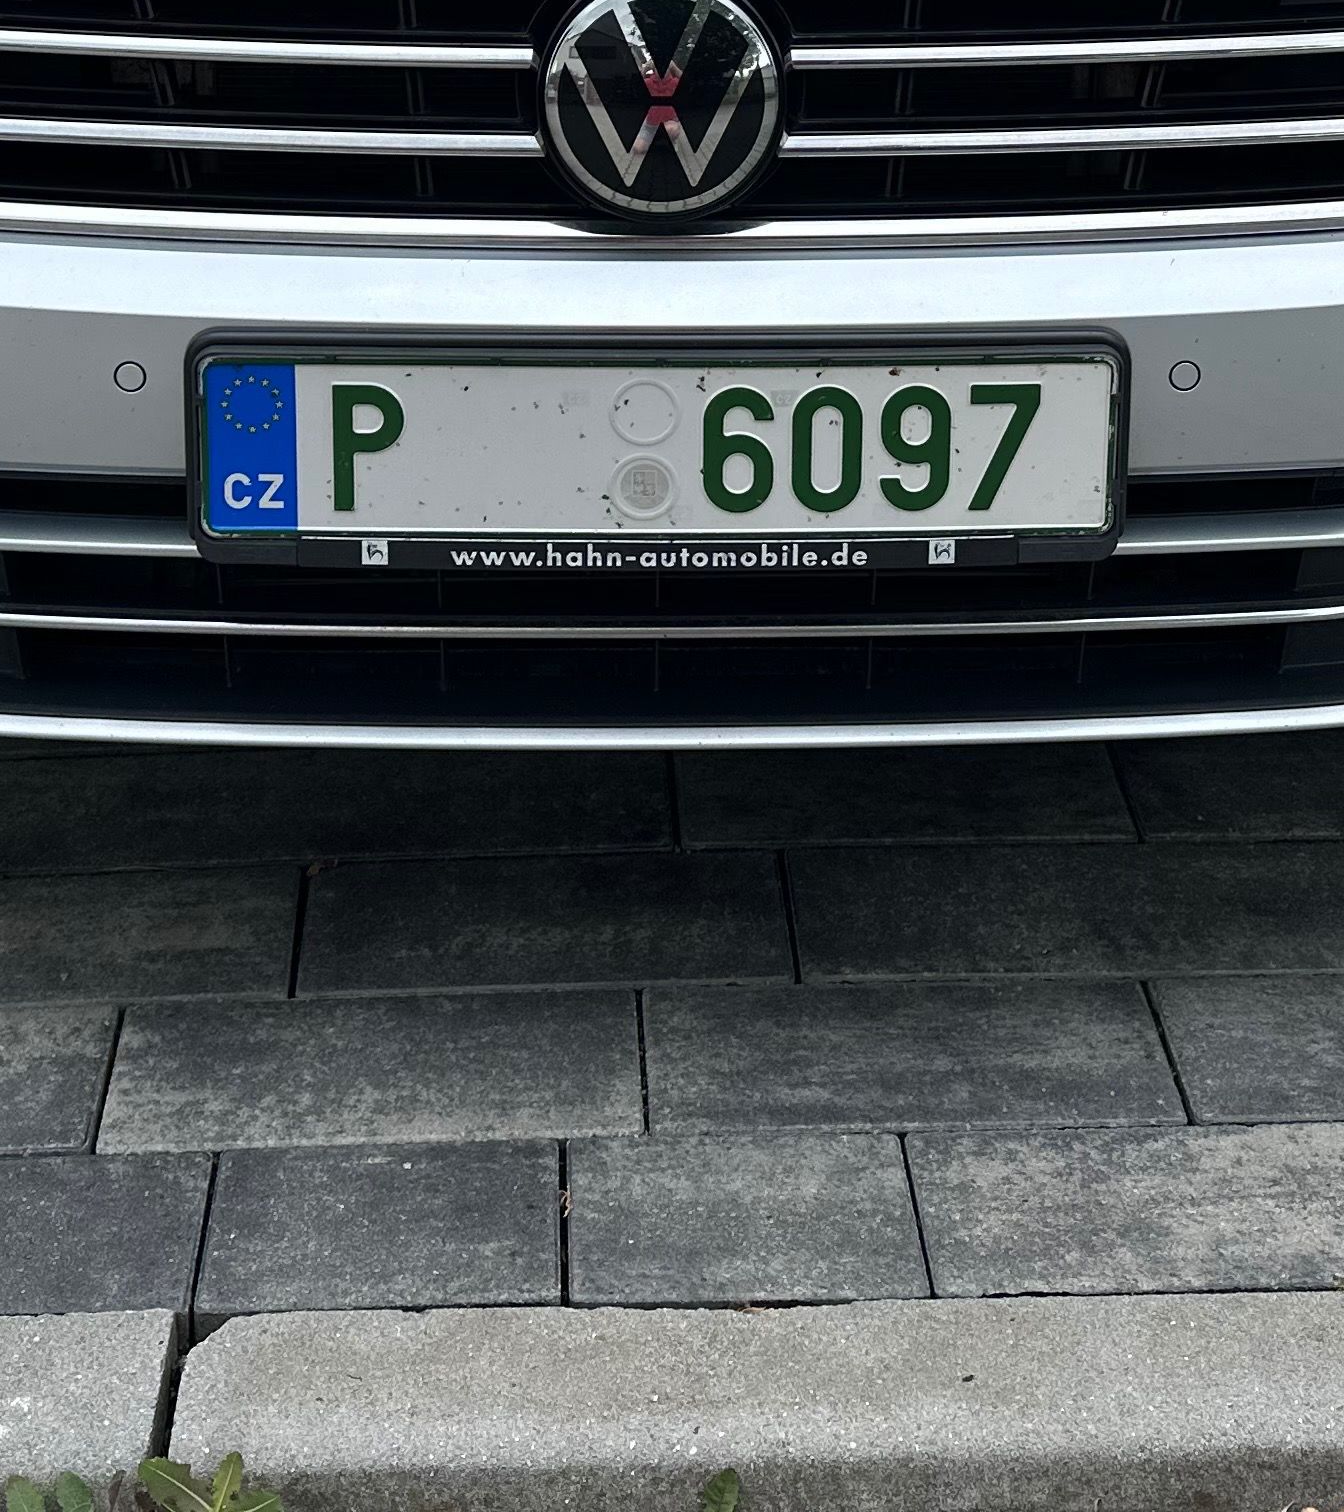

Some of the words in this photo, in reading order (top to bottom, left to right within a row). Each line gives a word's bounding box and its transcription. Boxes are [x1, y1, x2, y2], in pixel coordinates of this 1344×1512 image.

[332, 383, 405, 511] P
[702, 384, 1042, 512] 6097
[223, 473, 285, 510] CZ
[450, 542, 869, 569] www.hahn-automobile.de
